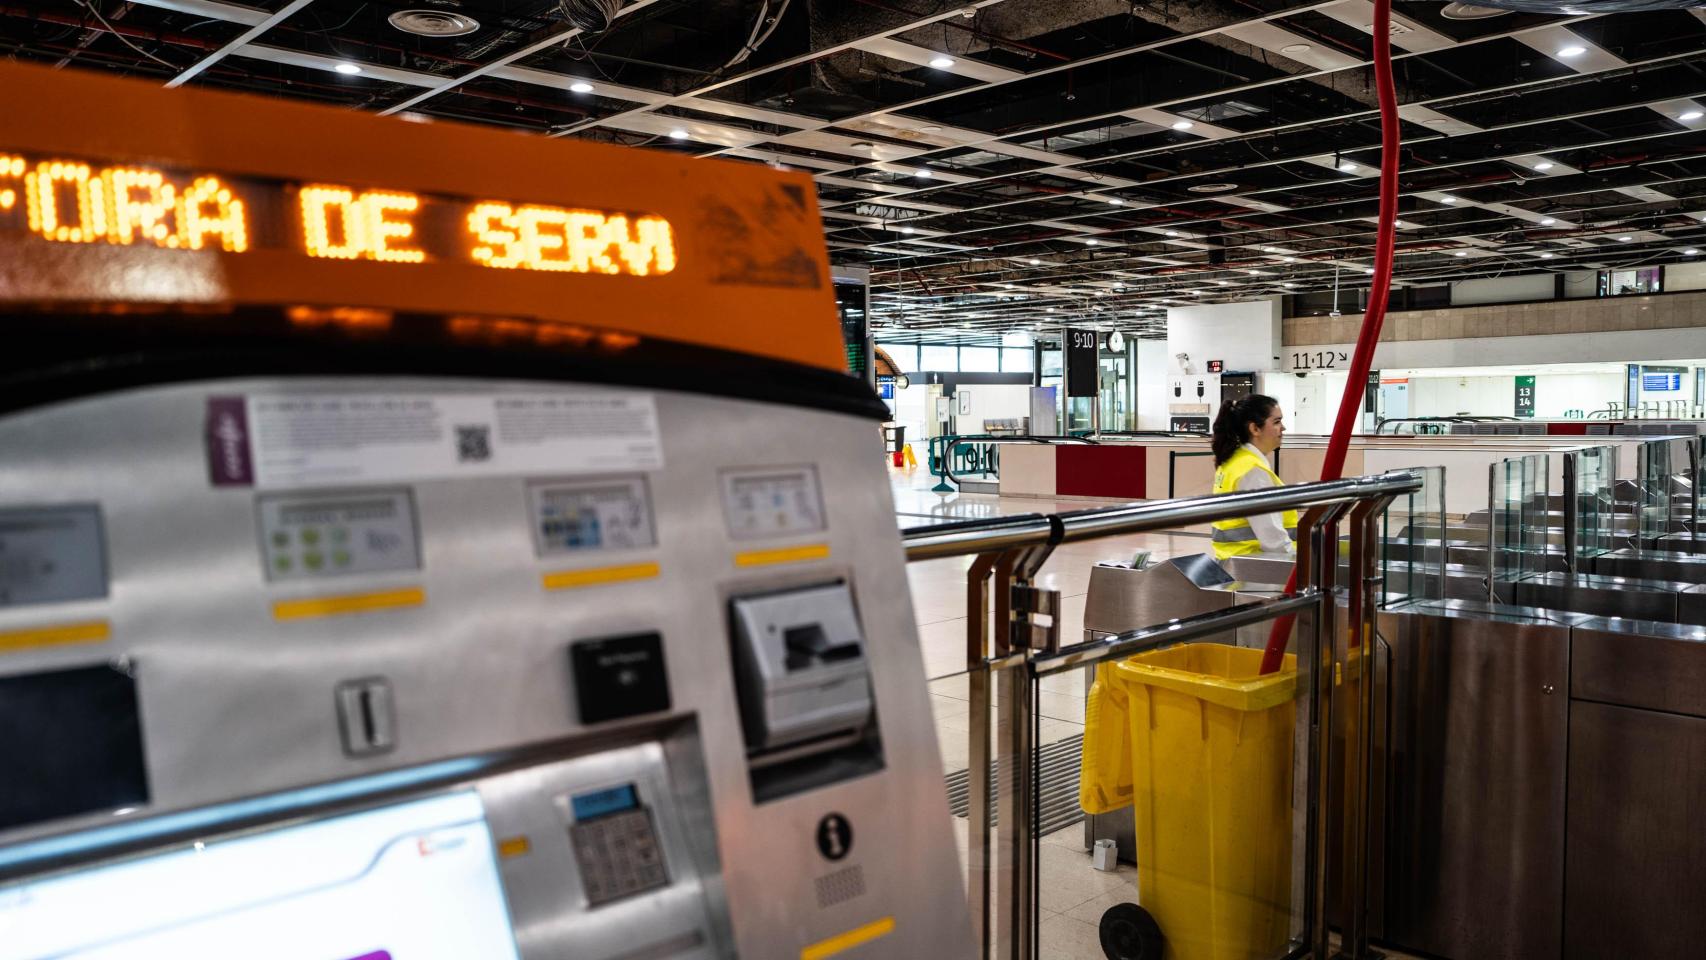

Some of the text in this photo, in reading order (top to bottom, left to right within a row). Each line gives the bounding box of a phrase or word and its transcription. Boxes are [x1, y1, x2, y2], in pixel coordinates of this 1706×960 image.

[300, 186, 425, 263] DE
[1519, 387, 1531, 396] 13
[1519, 397, 1531, 406] 14
